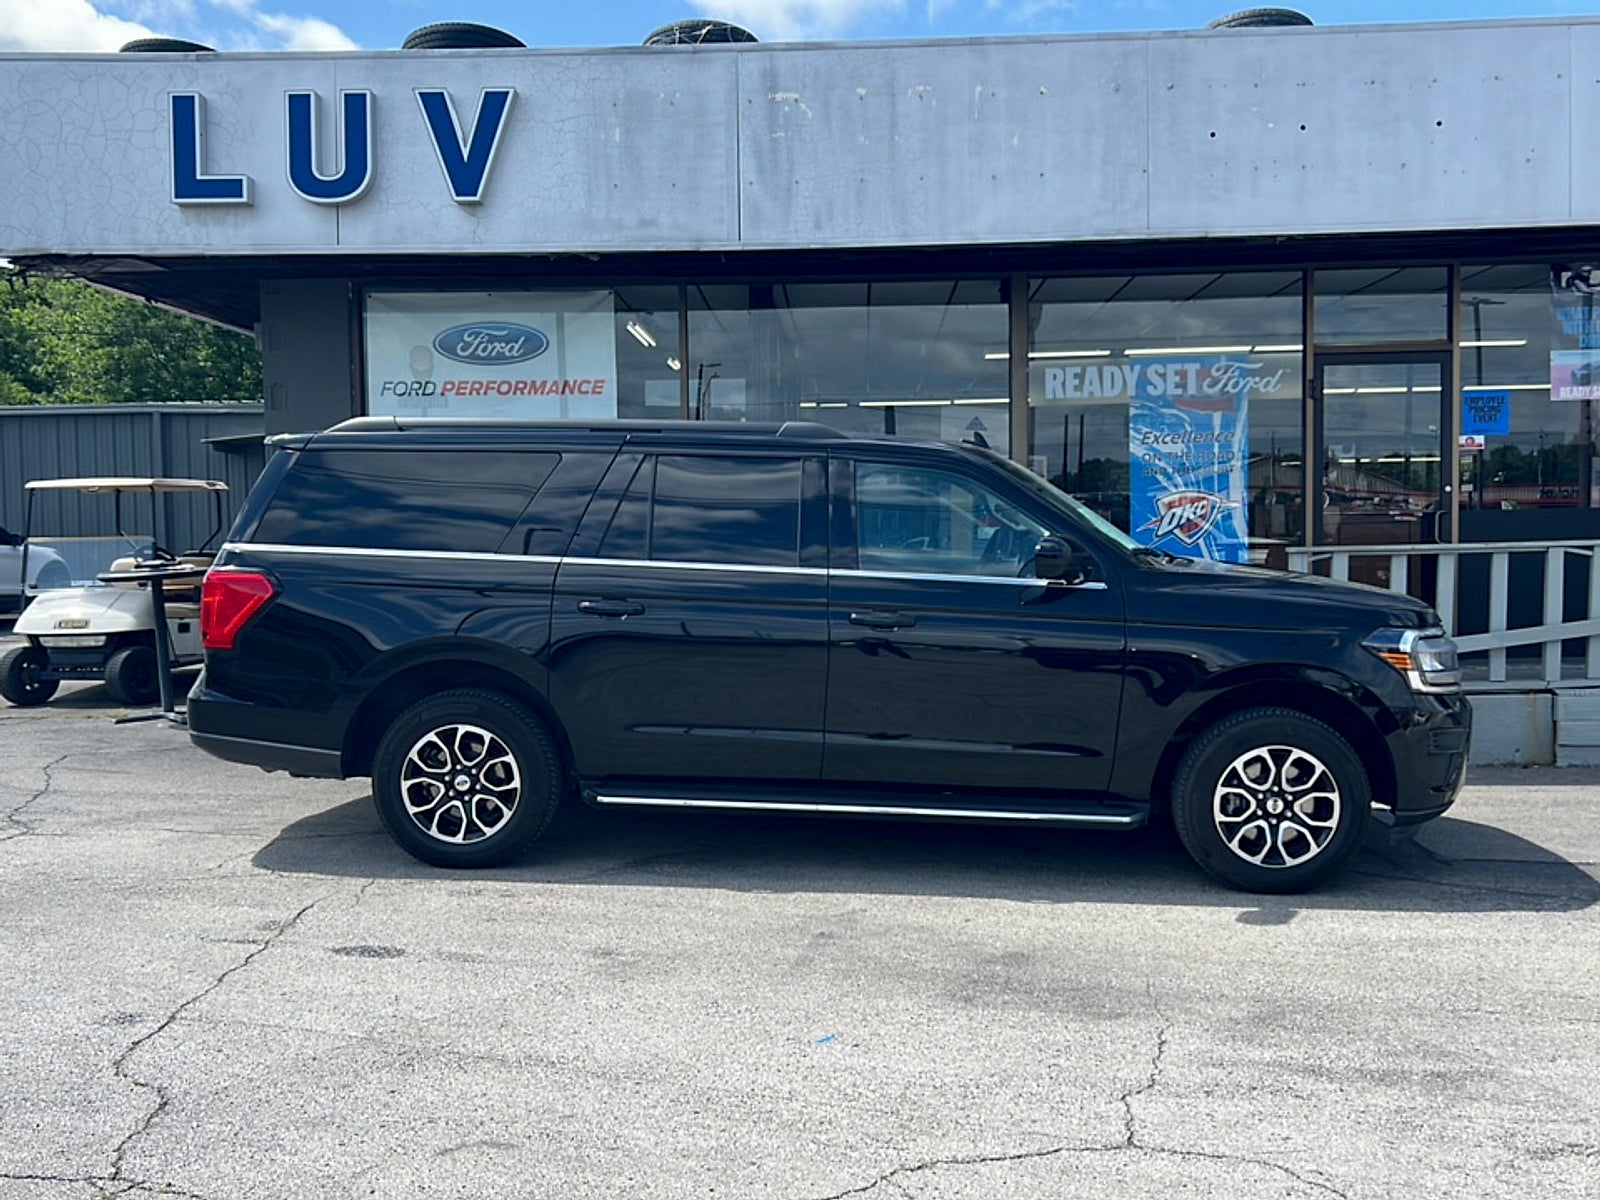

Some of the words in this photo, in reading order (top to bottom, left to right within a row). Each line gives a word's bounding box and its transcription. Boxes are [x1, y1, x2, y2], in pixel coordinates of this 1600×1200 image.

[168, 87, 517, 204] LUV
[456, 328, 525, 357] Ford
[380, 381, 437, 397] FORD
[440, 379, 605, 397] PERFORMANCE
[1045, 364, 1142, 400] READY
[1146, 362, 1200, 397] SET
[1203, 361, 1284, 394] Ford
[1560, 386, 1590, 398] READY
[1473, 413, 1499, 423] EVENT
[1141, 430, 1235, 445] Excellence
[1142, 453, 1162, 463] ON
[1168, 451, 1192, 461] THE
[1199, 450, 1235, 461] ROAD
[1157, 500, 1208, 537] OKC
